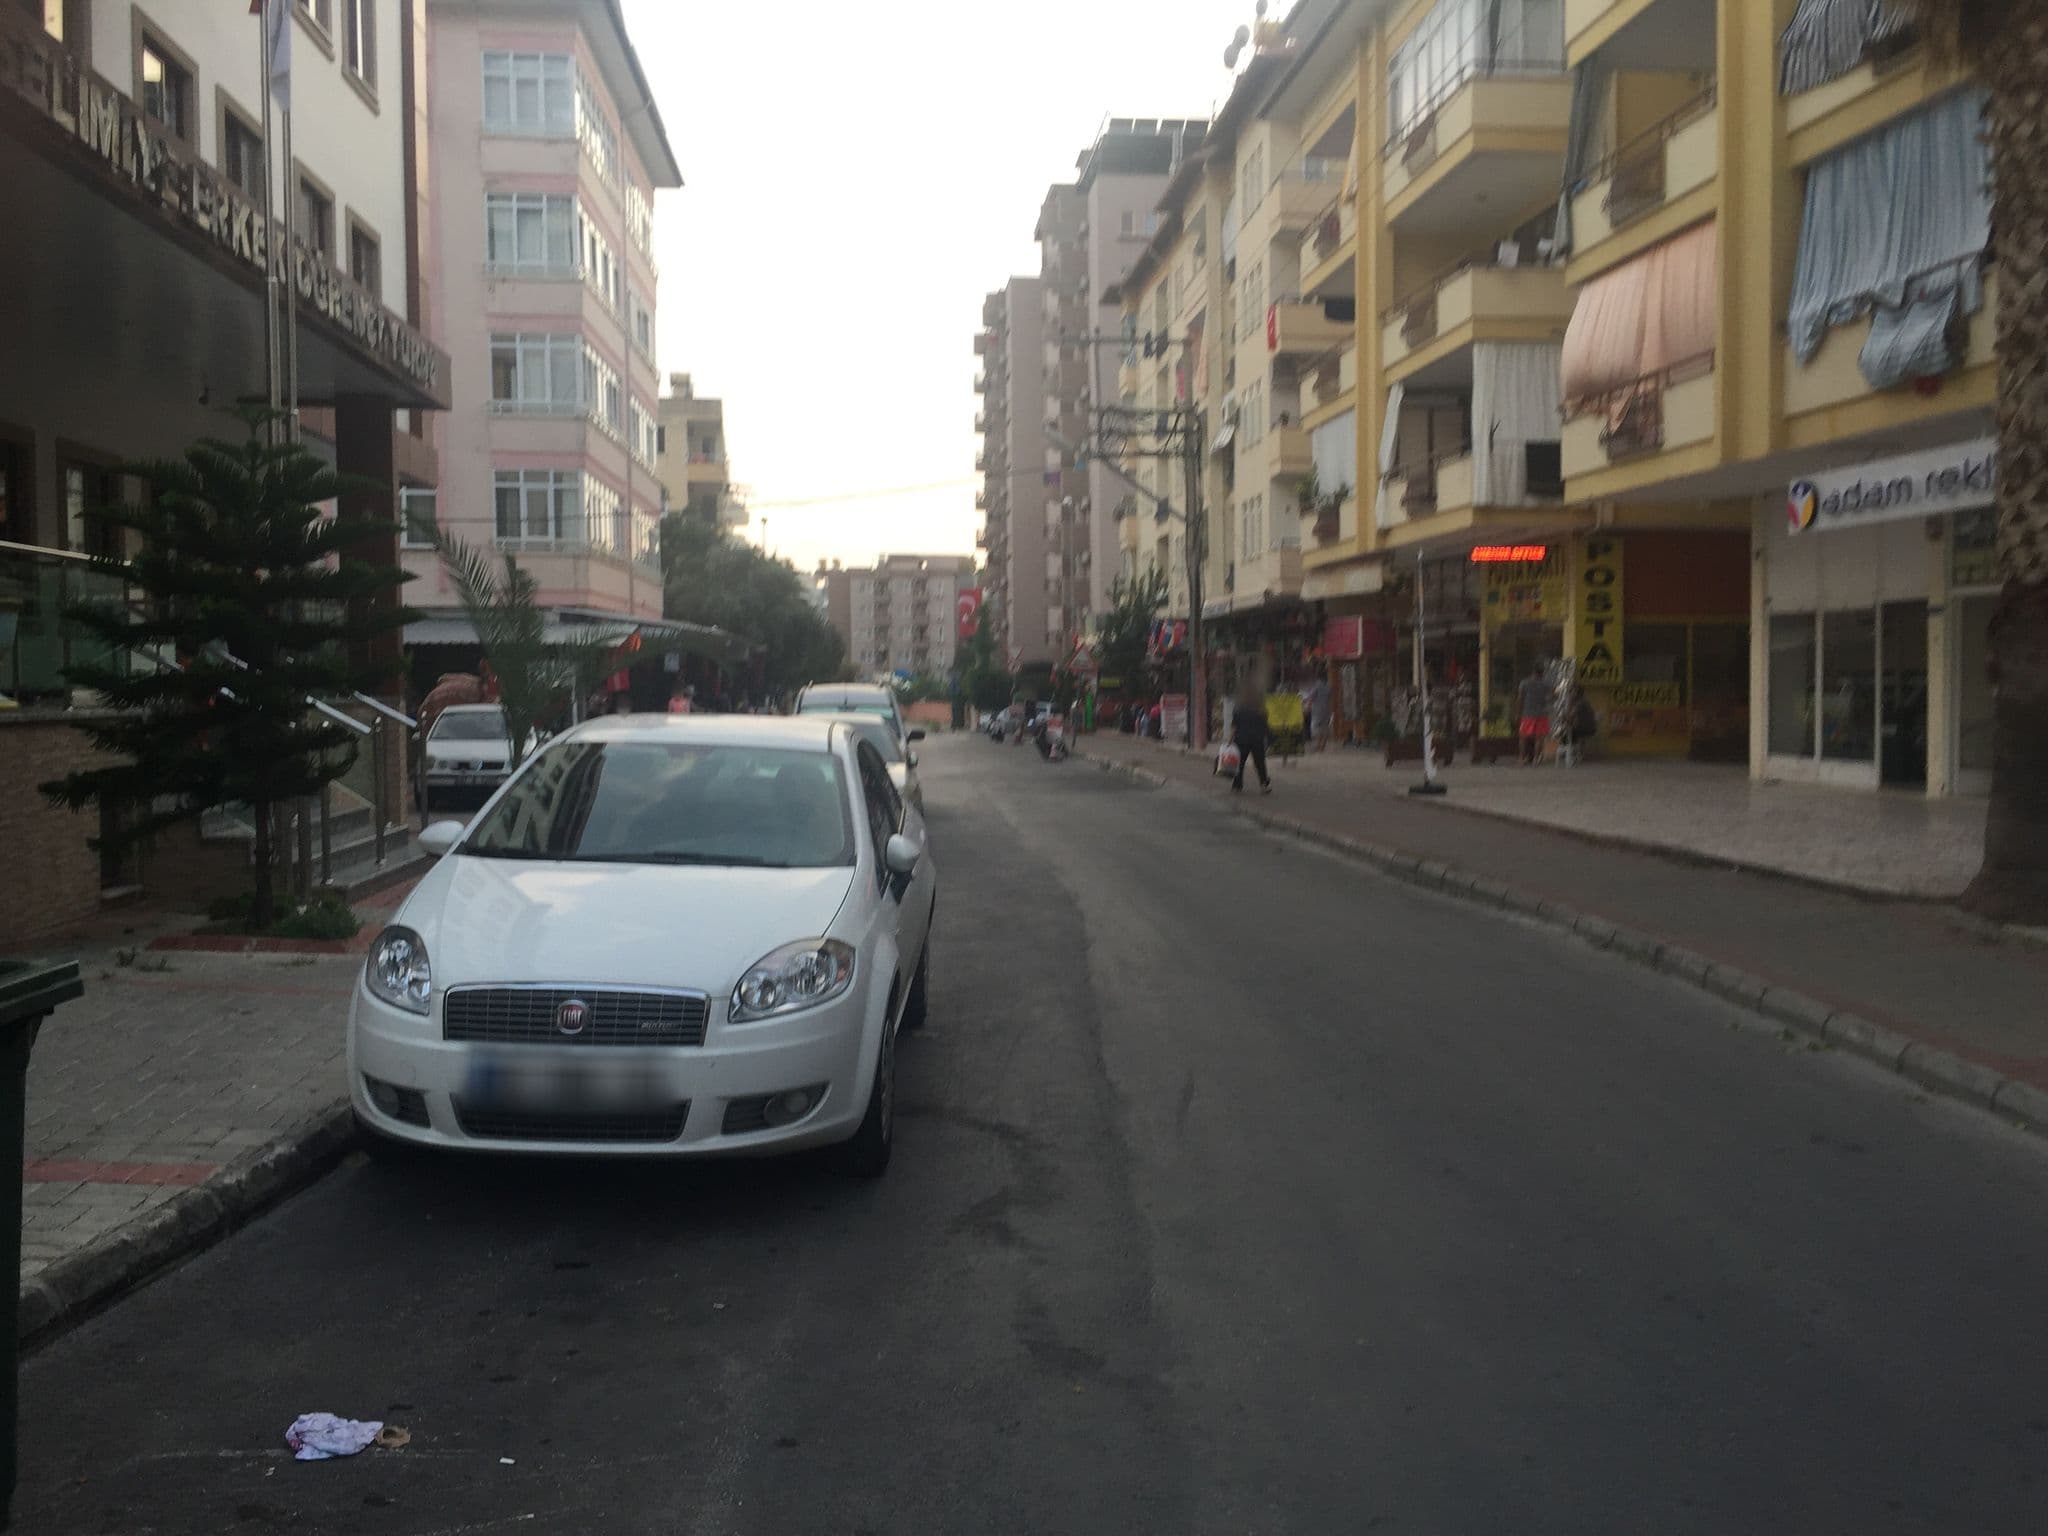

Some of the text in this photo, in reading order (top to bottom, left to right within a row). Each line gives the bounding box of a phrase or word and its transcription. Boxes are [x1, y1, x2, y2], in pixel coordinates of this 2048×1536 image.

[1822, 452, 1996, 517] adam rekl
[1583, 541, 1616, 663] POSTA
[562, 1009, 583, 1025] FIAT
